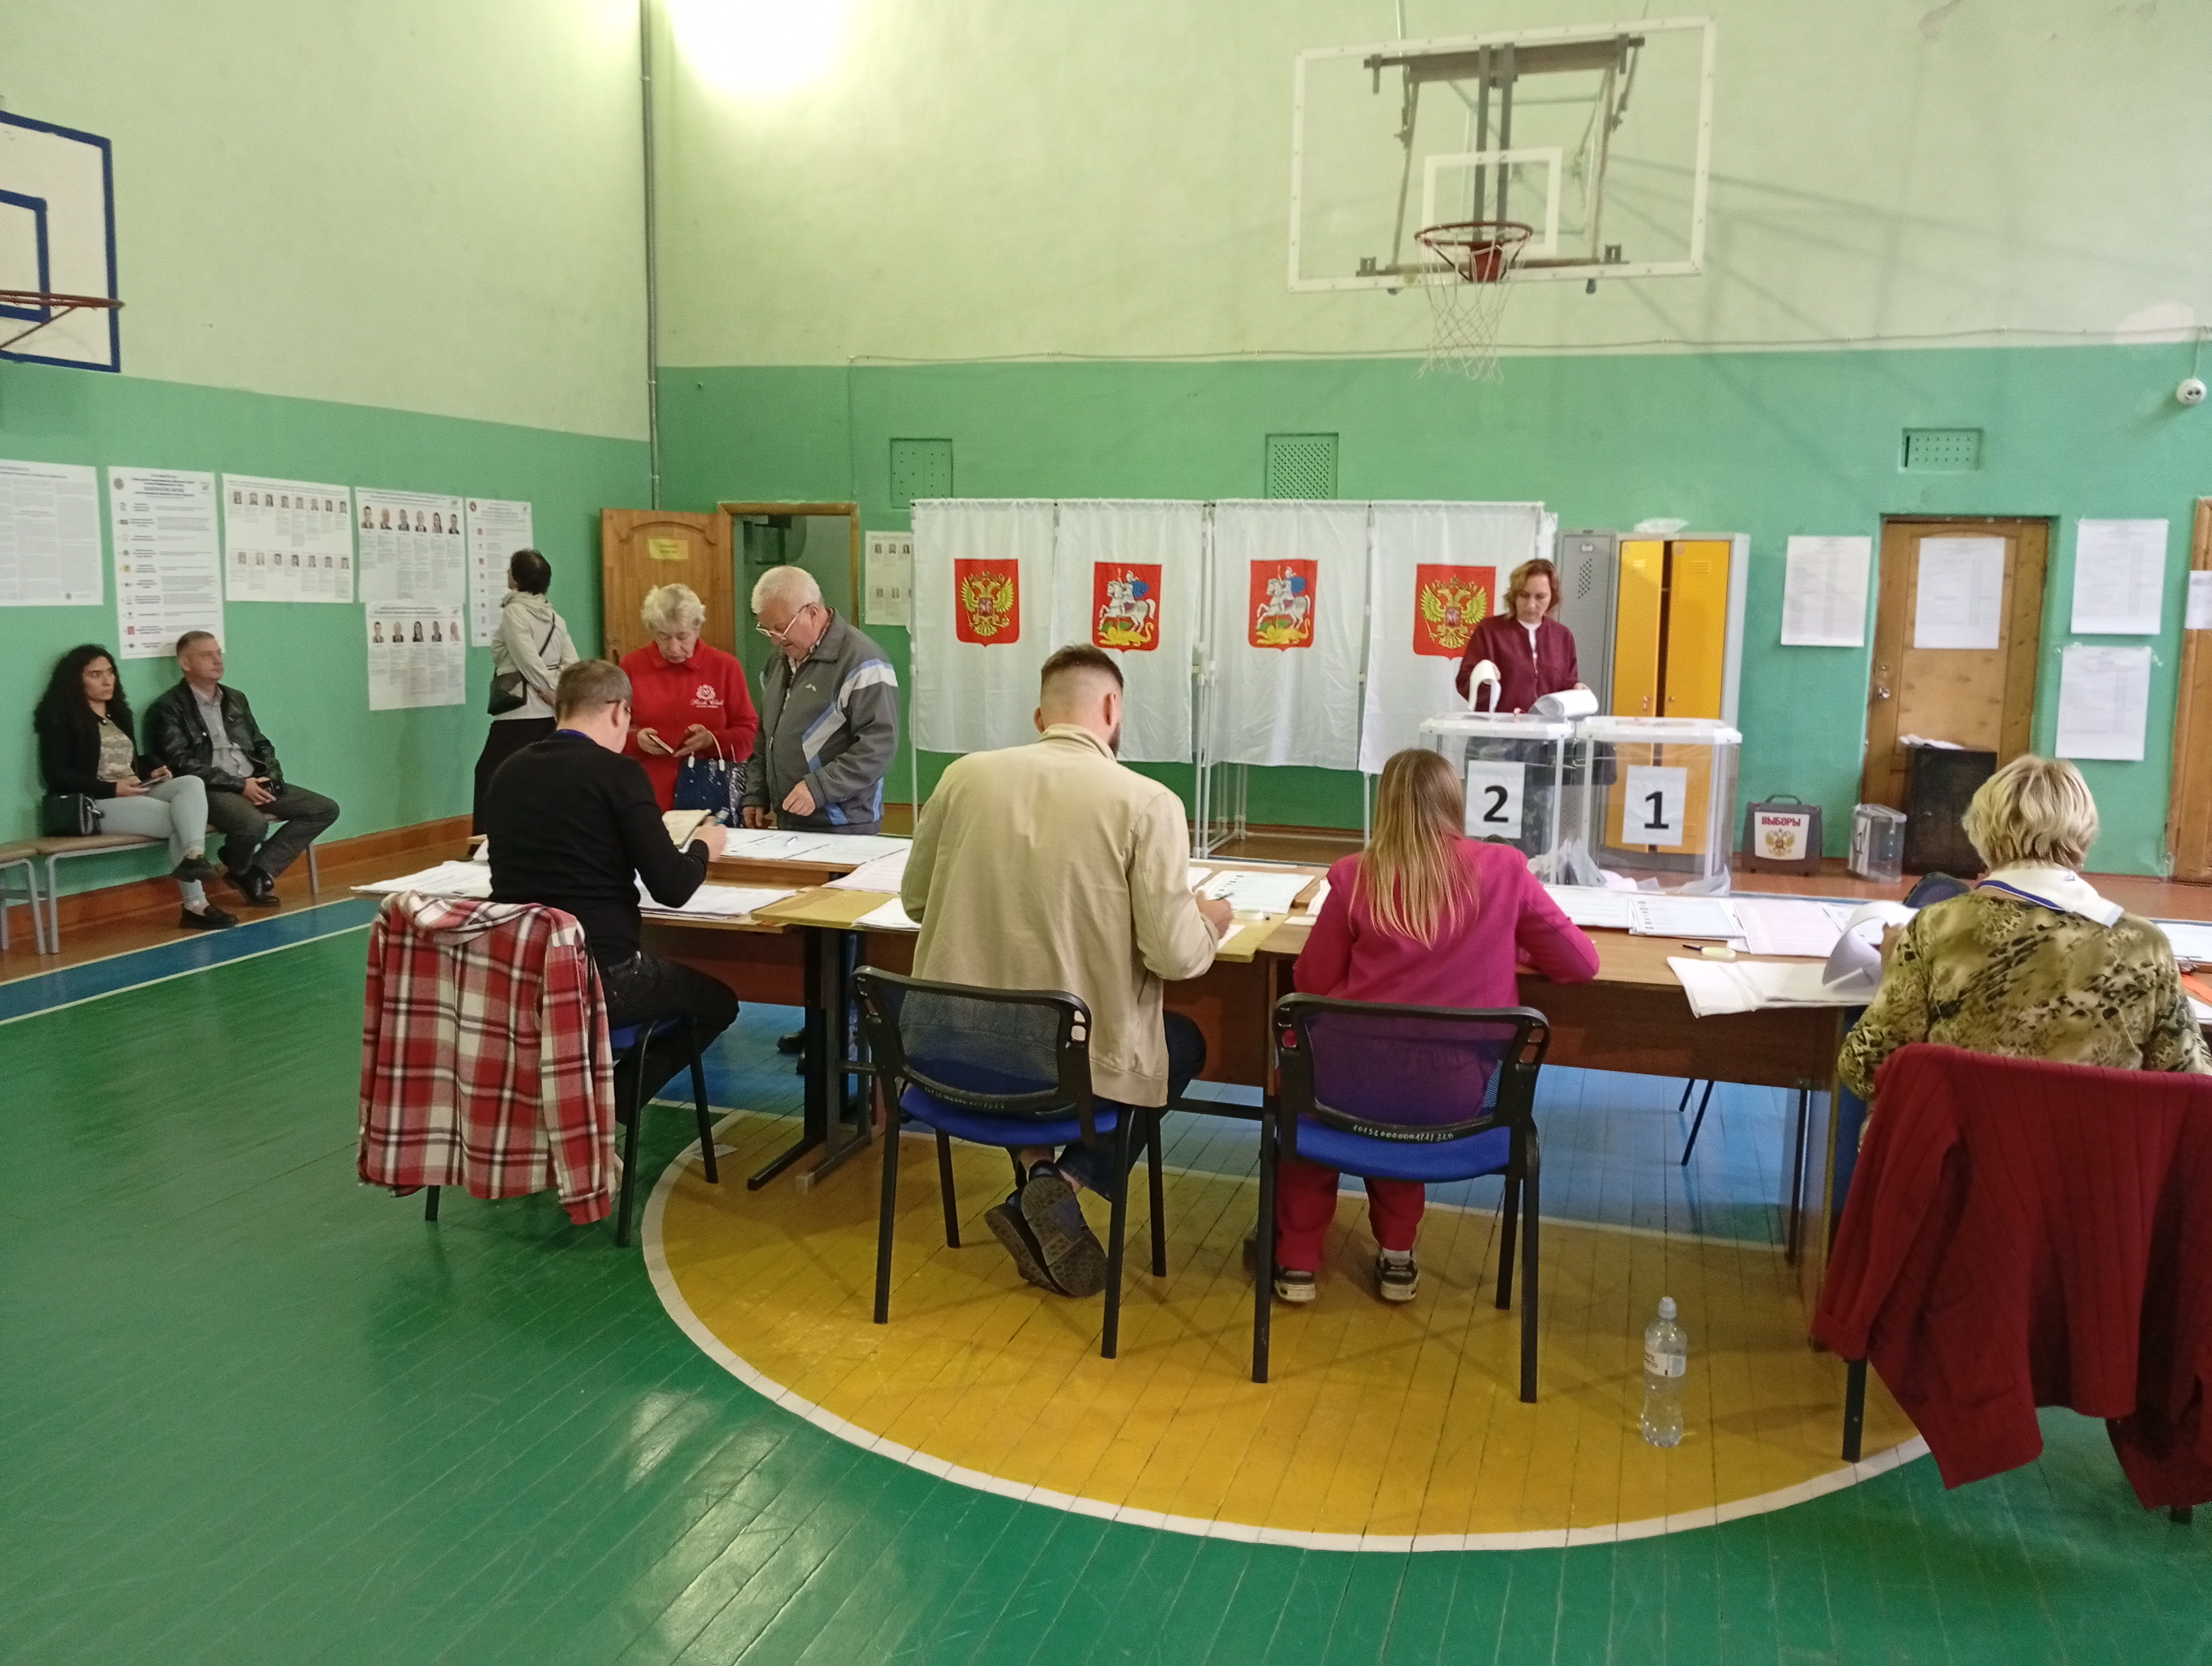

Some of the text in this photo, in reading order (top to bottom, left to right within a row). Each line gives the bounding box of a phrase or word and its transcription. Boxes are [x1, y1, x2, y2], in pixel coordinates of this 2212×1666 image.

[1483, 785, 1509, 823] 2
[1644, 791, 1669, 829] 1
[1762, 816, 1801, 826] ВЫБОРЫ
